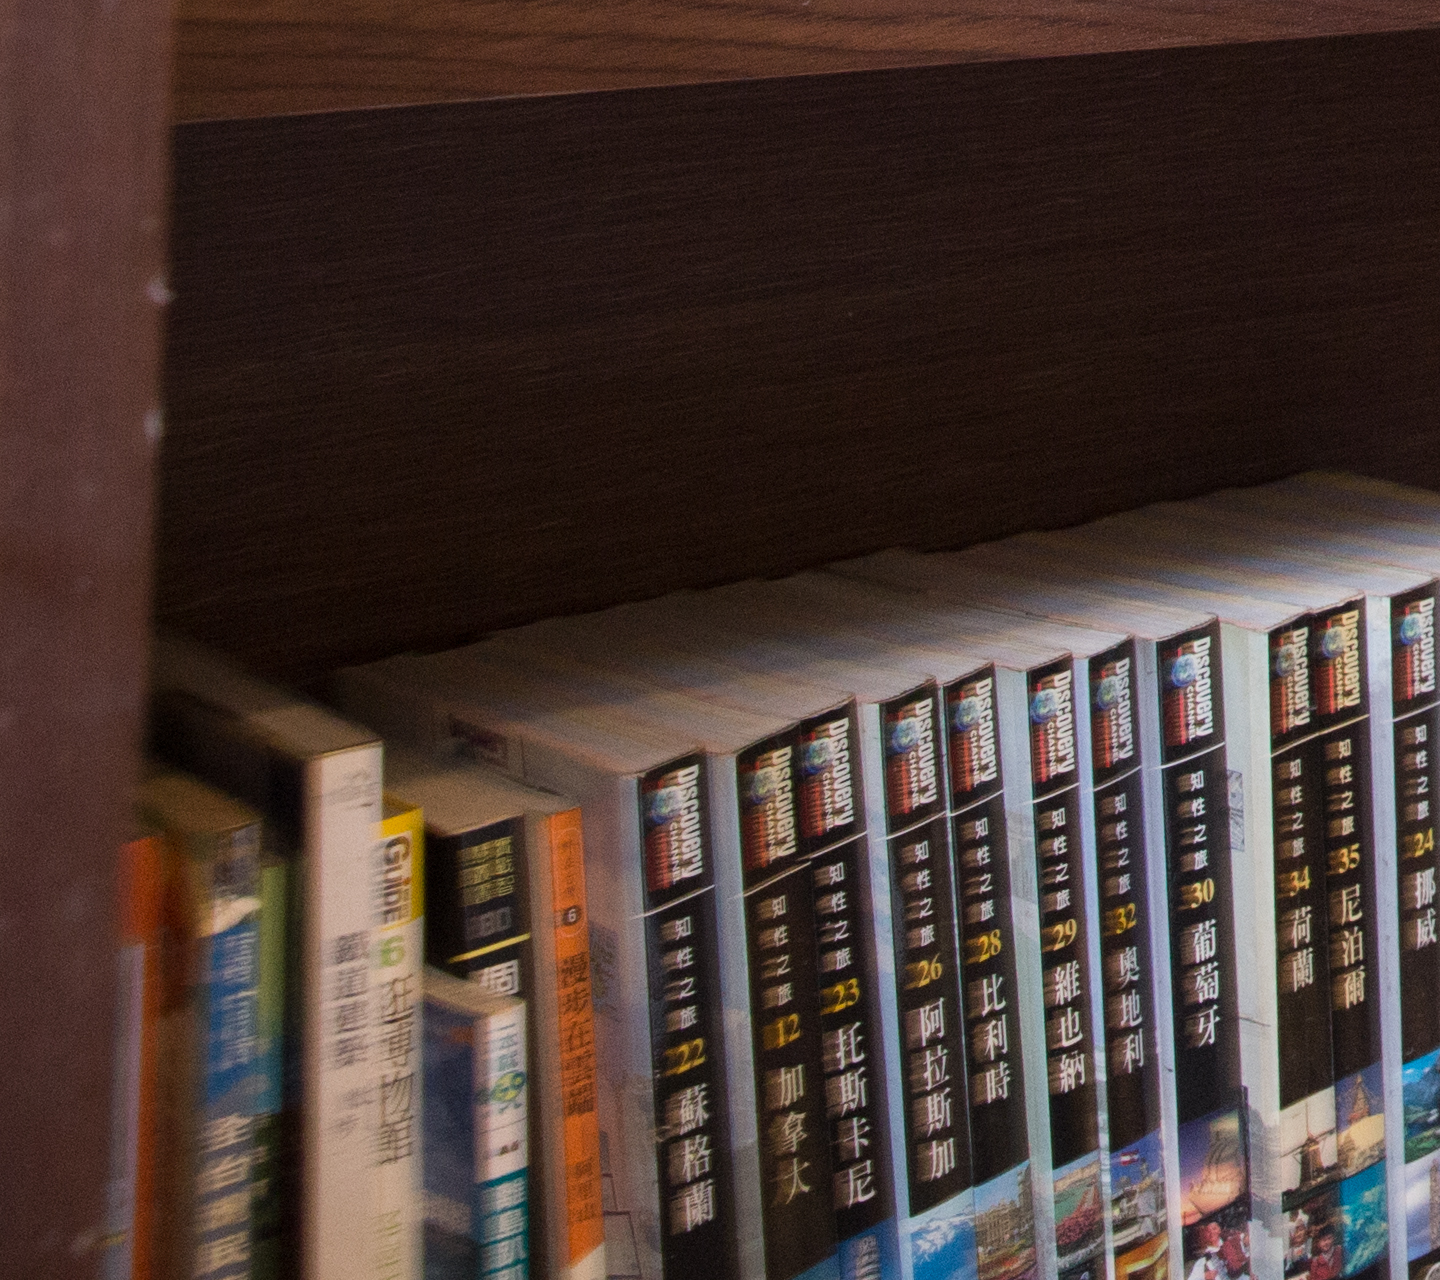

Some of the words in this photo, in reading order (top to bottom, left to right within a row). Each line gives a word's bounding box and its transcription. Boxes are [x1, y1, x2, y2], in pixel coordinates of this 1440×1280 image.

[1338, 738, 1356, 837] 知性之旅
[1415, 726, 1430, 819] 知性之旅
[1291, 907, 1315, 994] 荷蘭
[1340, 883, 1366, 1010] 尼泊爾
[1413, 868, 1438, 950] 挪威
[980, 973, 1010, 1105] 比利時
[1053, 959, 1087, 1095] 維也納
[1118, 945, 1144, 1075] 奧地利
[1192, 918, 1222, 1048] 葡萄牙
[780, 1063, 811, 1206] 加拿大
[834, 1021, 877, 1210] 托斯卡尼
[919, 997, 956, 1183] 阿拉斯加
[679, 1083, 714, 1235] 蘇格蘭
